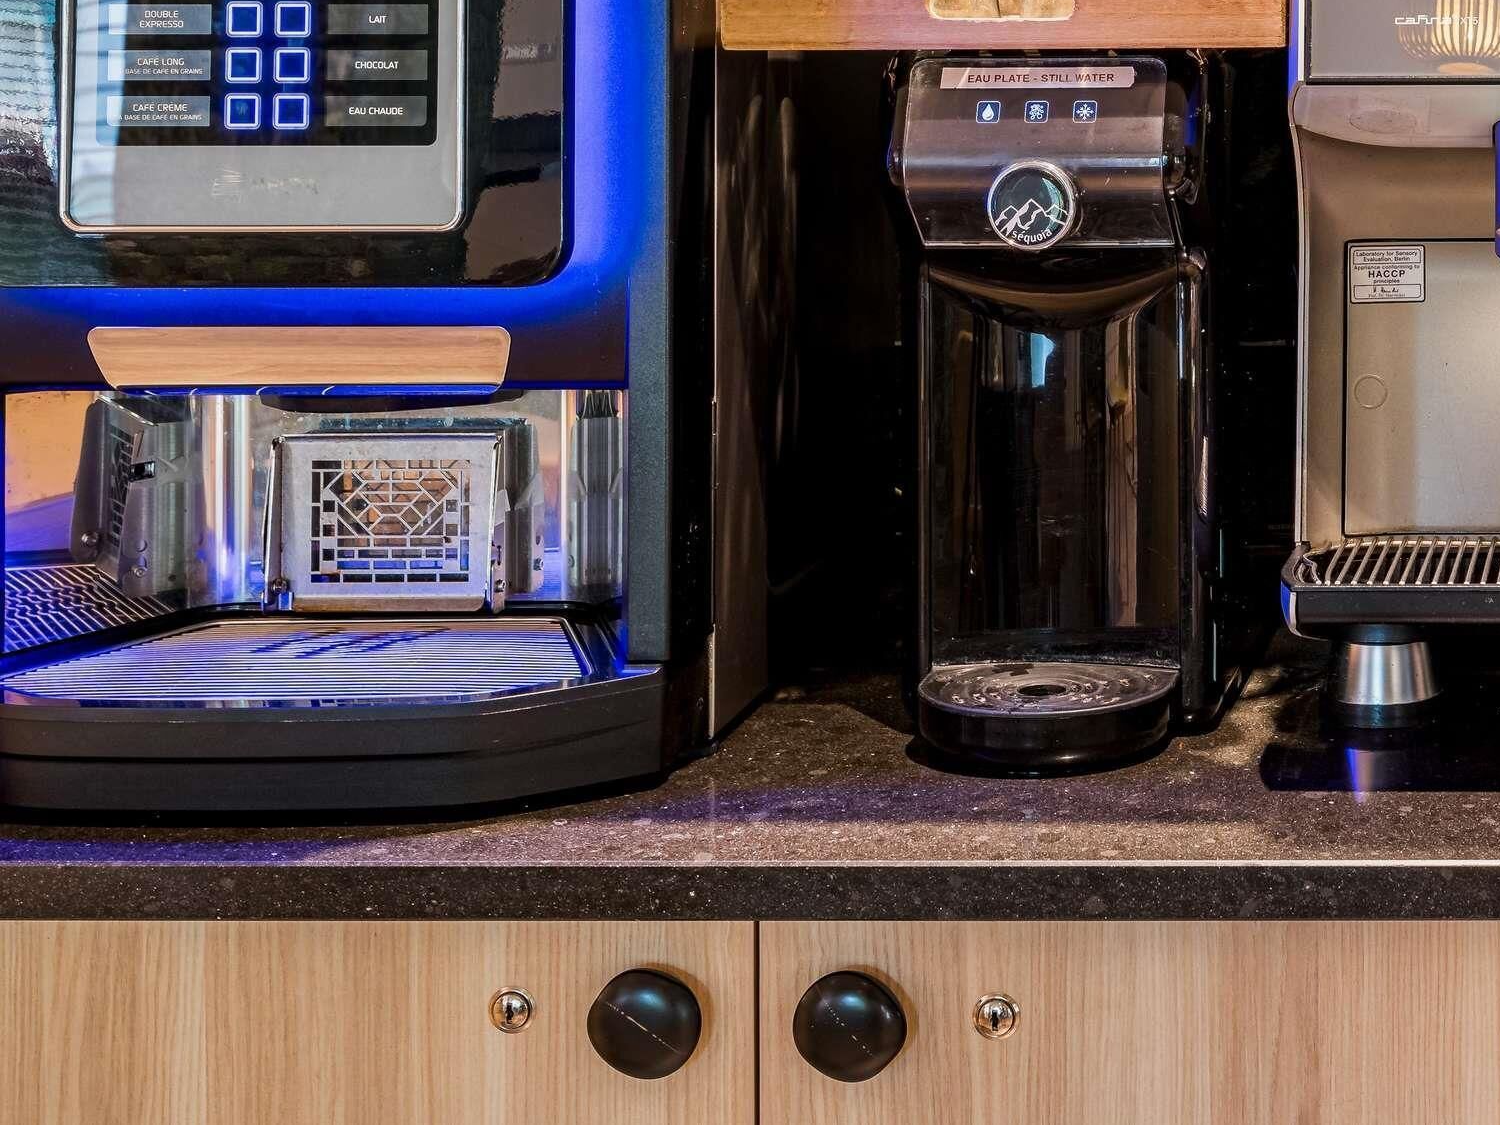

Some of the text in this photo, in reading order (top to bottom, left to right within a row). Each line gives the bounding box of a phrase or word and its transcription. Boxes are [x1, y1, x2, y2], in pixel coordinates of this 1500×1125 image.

[144, 10, 179, 18] DOUBLE
[139, 20, 184, 28] EXPRESSO
[368, 15, 387, 24] LAIT
[162, 58, 185, 66] LONG
[355, 60, 399, 69] CHOCOLAT
[967, 73, 1115, 83] EAU PLATE STILL WATER
[348, 107, 404, 115] EAU CHAUDE
[1011, 228, 1053, 245] séquoia
[1368, 270, 1406, 279] HACCP
